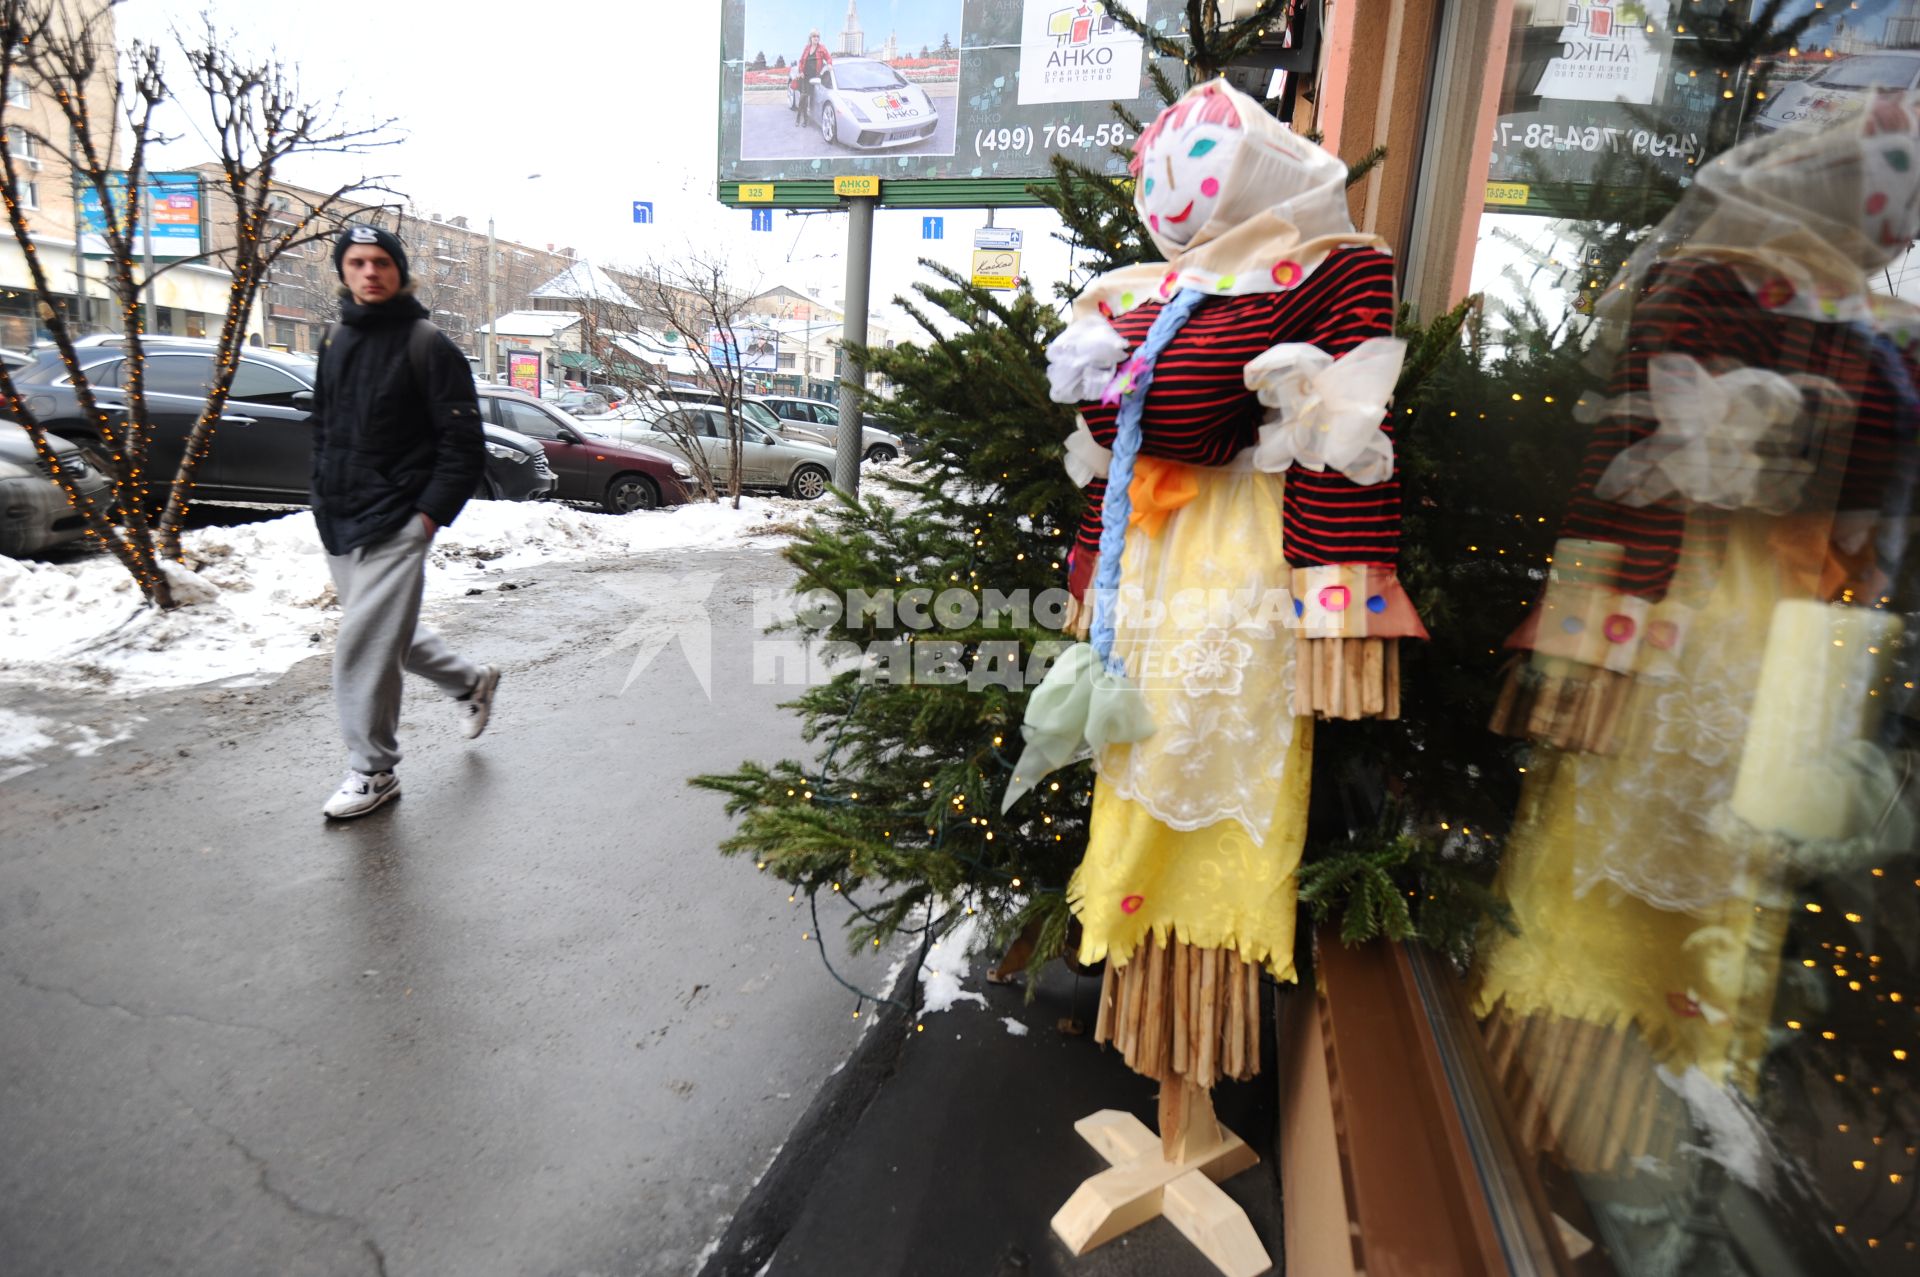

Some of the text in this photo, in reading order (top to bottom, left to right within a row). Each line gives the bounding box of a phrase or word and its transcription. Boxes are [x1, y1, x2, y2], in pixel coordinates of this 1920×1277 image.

[1046, 47, 1113, 68] АНКО
[1045, 67, 1112, 77] рекламное
[1045, 74, 1112, 84] агентство
[886, 109, 919, 121] АНКО
[975, 126, 1034, 158] (499)
[839, 180, 871, 189] АНКО
[748, 188, 763, 197] 325
